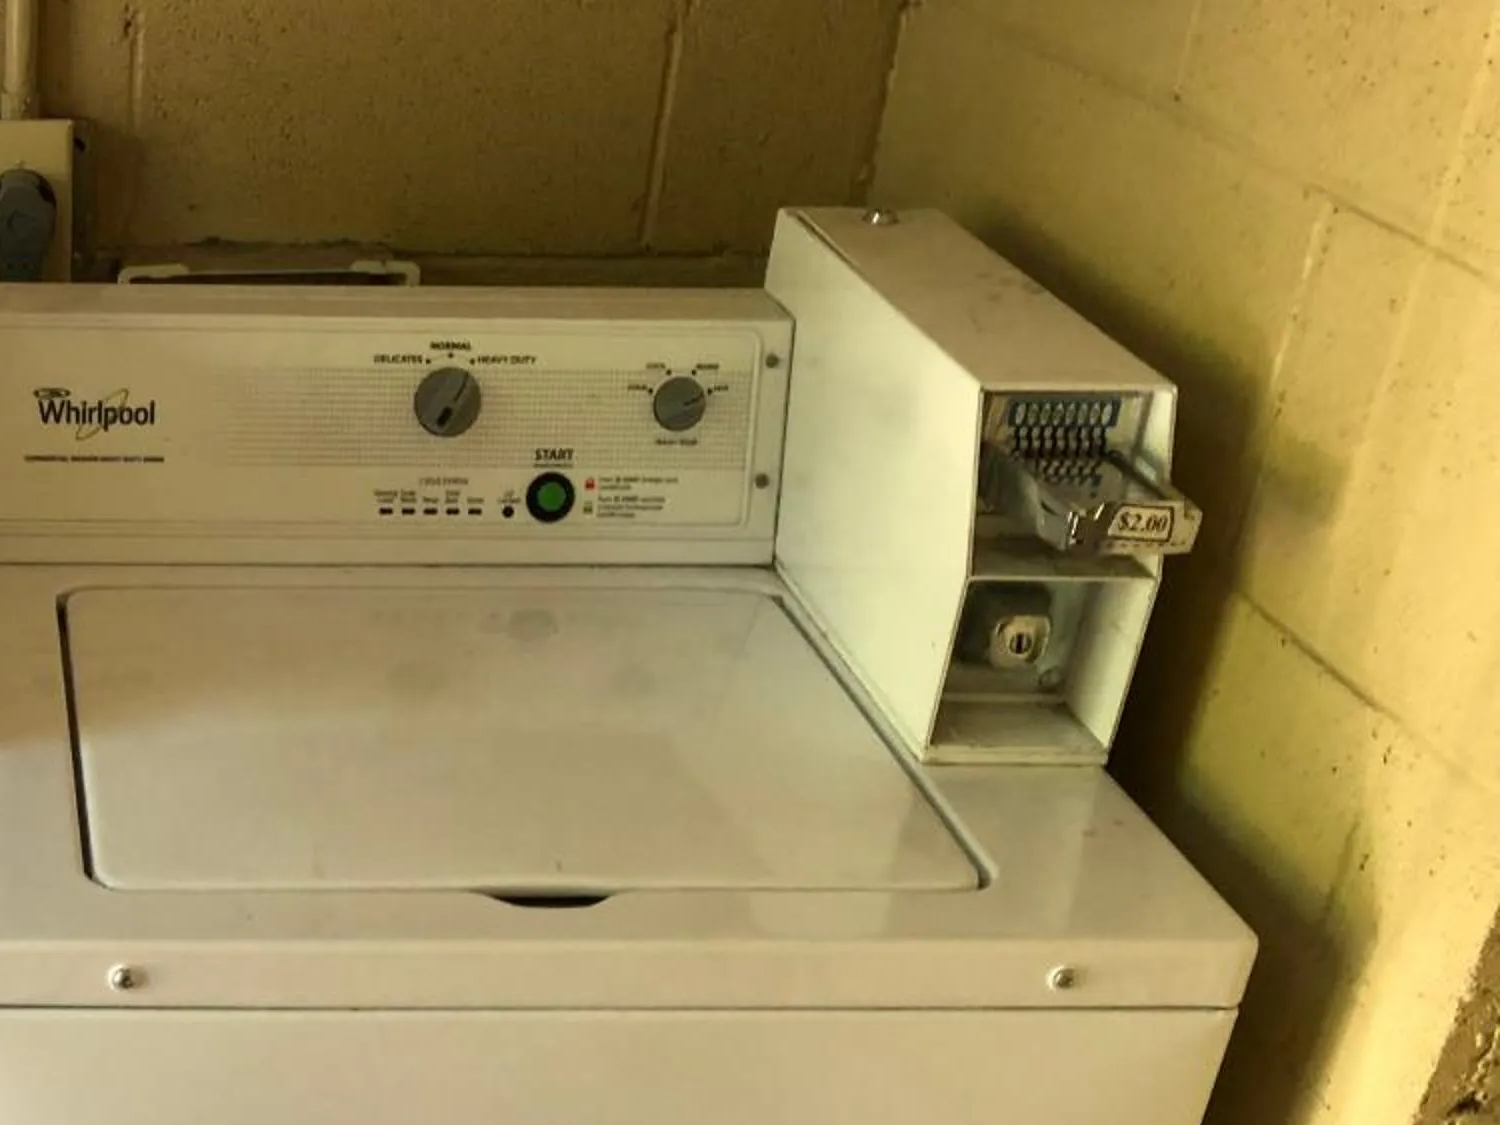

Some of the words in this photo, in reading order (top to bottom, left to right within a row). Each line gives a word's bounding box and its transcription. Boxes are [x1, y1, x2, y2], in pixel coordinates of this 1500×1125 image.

[37, 399, 156, 432] Whirlpool
[534, 448, 574, 461] START
[1116, 512, 1168, 533] $2.00
